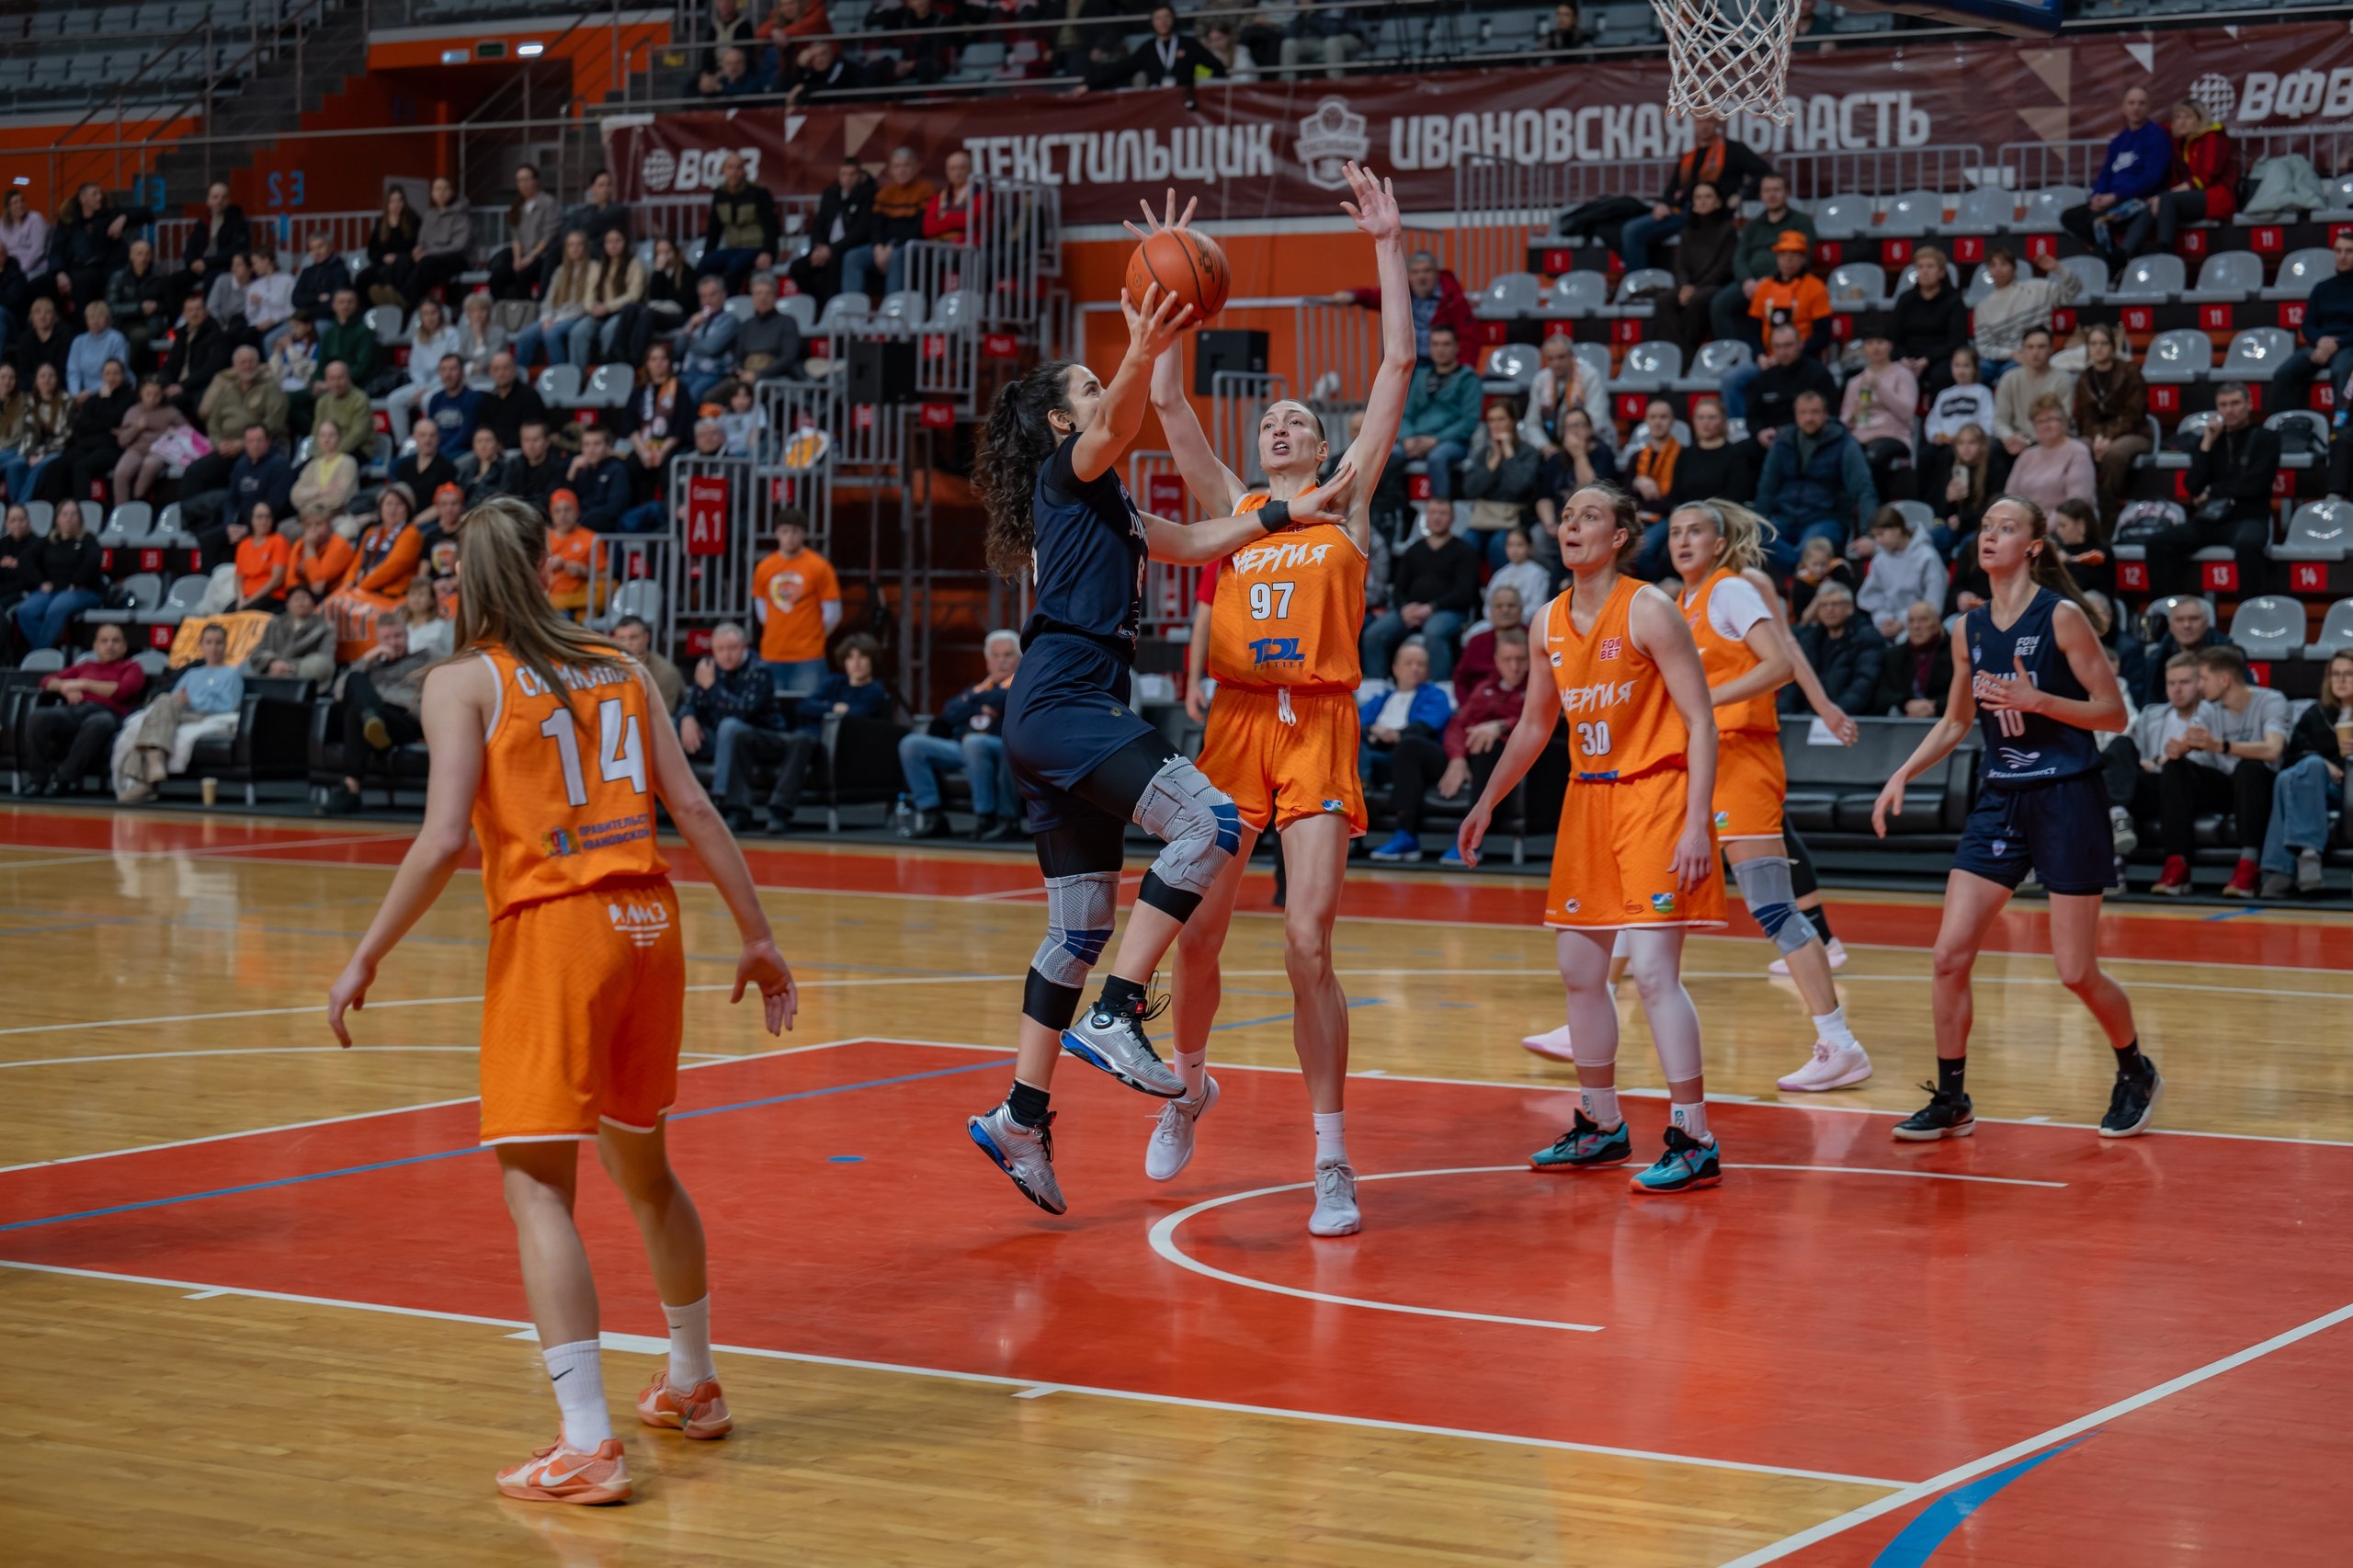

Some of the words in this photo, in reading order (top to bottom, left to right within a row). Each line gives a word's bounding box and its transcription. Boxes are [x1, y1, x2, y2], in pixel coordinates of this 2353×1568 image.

[1390, 103, 1693, 169] ИВАНОВСКАЯ
[962, 123, 1274, 185] ТЕКСТИЛЬЩИК
[2261, 230, 2274, 247] 11
[1964, 240, 1975, 258] 7
[1553, 253, 1563, 269] 1
[2129, 311, 2145, 329] 10
[2209, 308, 2223, 326] 11
[2287, 306, 2303, 324] 12
[1488, 325, 1496, 341] 1
[1621, 323, 1632, 341] 3
[2156, 389, 2170, 407] 11
[2319, 386, 2335, 405] 13
[1626, 398, 1638, 415] 4
[1418, 478, 1430, 497] 2
[1232, 542, 1336, 580] НЕРГИЯ
[2124, 566, 2142, 585] 12
[2212, 566, 2229, 585] 13
[2300, 566, 2317, 586] 14
[1249, 582, 1295, 620] 97
[1248, 638, 1305, 664] TDL
[1600, 648, 1620, 660] BET
[1560, 680, 1638, 713] НЕРГИЯ
[1994, 709, 2026, 738] 10
[1576, 720, 1612, 756] 30
[540, 699, 647, 807] 14
[579, 813, 649, 837] ПРАВИТЕЛЬСТ
